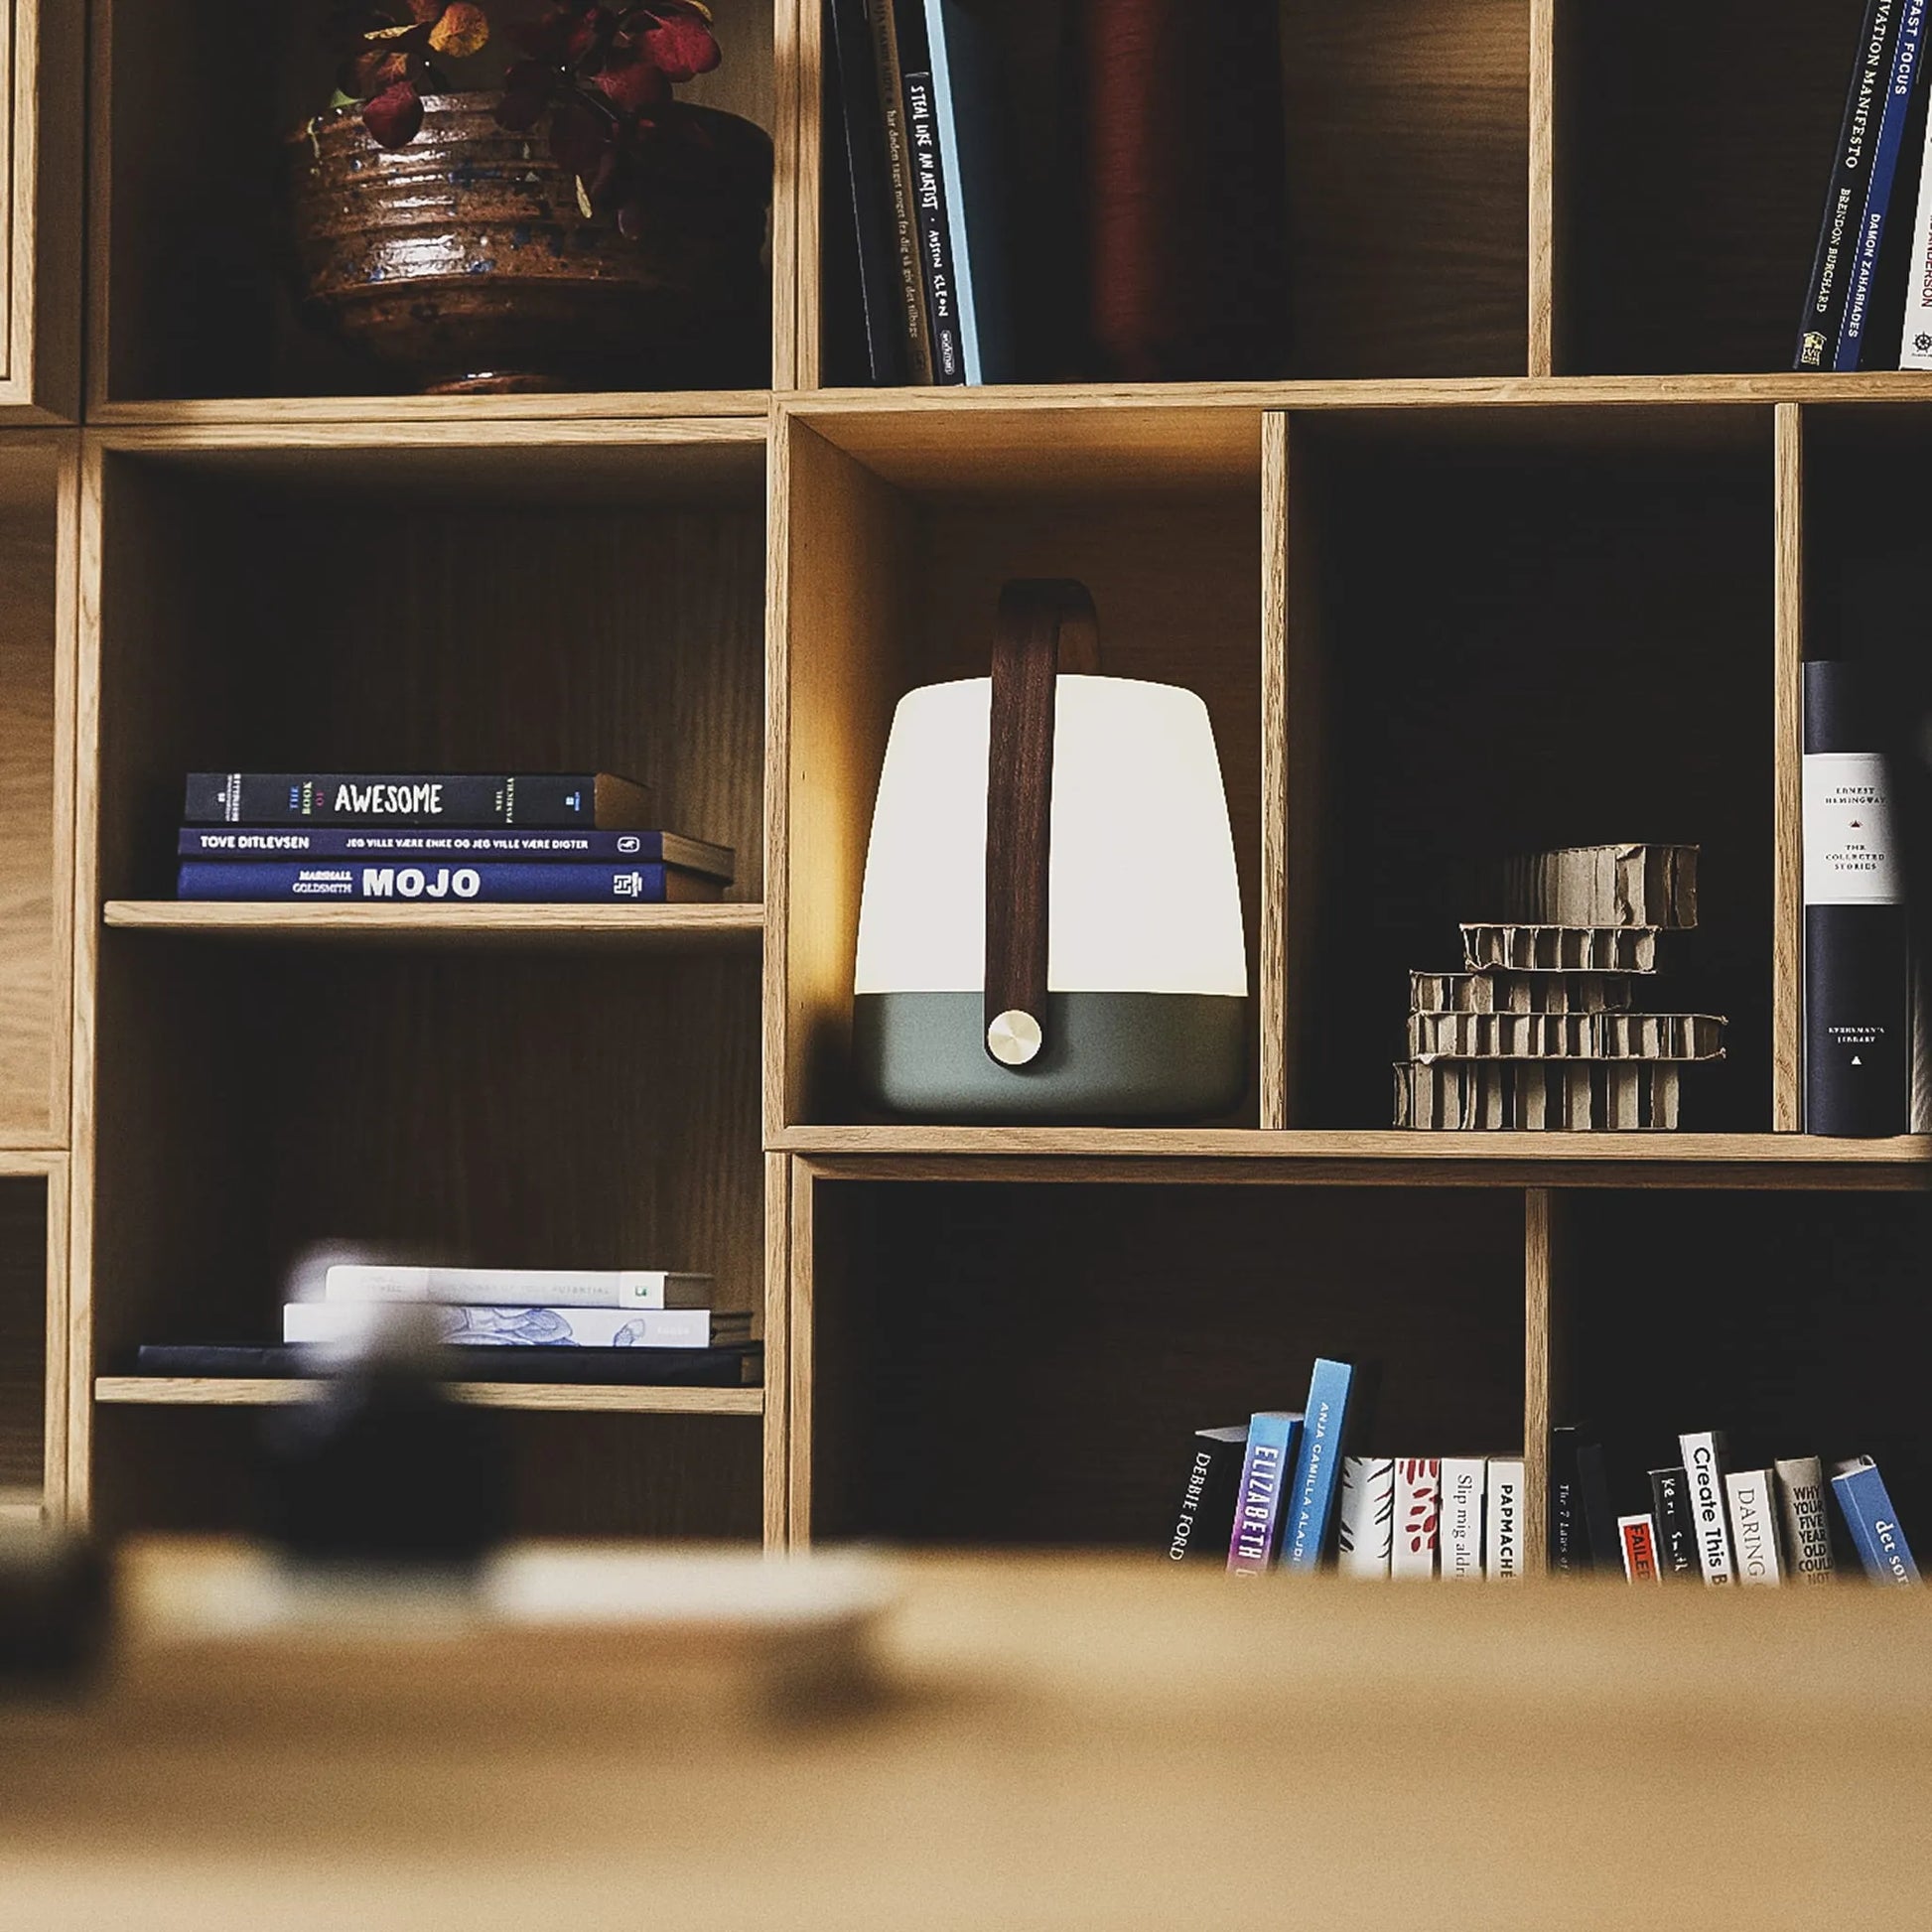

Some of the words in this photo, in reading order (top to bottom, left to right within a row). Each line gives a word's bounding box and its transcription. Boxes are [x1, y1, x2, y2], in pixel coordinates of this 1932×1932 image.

[1905, 0, 1924, 37] FAST
[1894, 43, 1915, 95] FOCUS
[910, 85, 929, 120] STEAL
[1845, 69, 1877, 169] MANIFESTO
[914, 124, 932, 147] LIKE
[918, 153, 933, 168] AN
[918, 171, 938, 210] ARTIST
[1830, 188, 1852, 246] BRENDON
[1863, 213, 1881, 258] DAMON
[928, 229, 942, 268] AUSTIN
[933, 274, 949, 317] KLEON
[1816, 246, 1839, 313] BURCHARD
[1848, 260, 1872, 339] ZAHARIADES
[302, 781, 313, 815] BOOK
[335, 783, 443, 814] AWESOME
[201, 836, 235, 849] TOVE
[237, 836, 310, 850] DITLEVSEN
[346, 838, 364, 848] JEG
[366, 838, 393, 848] VILLE
[425, 839, 452, 848] ENKE
[454, 839, 470, 849] OG
[472, 839, 490, 849] JEG
[492, 839, 520, 849] VILLE
[552, 840, 589, 850] DIGTER
[292, 883, 352, 894] GOLDSMITH
[362, 869, 481, 897] MOJO
[1315, 1402, 1329, 1439] ANJA
[1182, 1451, 1211, 1511] DEBBIE
[1304, 1444, 1321, 1506] CAMILLA
[1453, 1474, 1472, 1505] Slip
[1793, 1485, 1821, 1501] WHY
[1238, 1446, 1279, 1559] ELIZABETH
[1693, 1448, 1717, 1523] Create
[1705, 1528, 1725, 1568] This
[1793, 1500, 1824, 1516] YOUR
[1169, 1513, 1193, 1561] FORD
[1451, 1509, 1470, 1539] mig
[1661, 1478, 1675, 1515] Keri
[1671, 1531, 1688, 1572] Smith
[1737, 1488, 1766, 1577] DARING
[1798, 1514, 1823, 1530] FIVE
[1798, 1530, 1826, 1545] YEAR
[1874, 1520, 1895, 1553] det
[1455, 1544, 1470, 1581] aldri
[1628, 1524, 1651, 1581] FAILED
[1798, 1558, 1833, 1574] COULD
[1803, 1544, 1827, 1559] OLD
